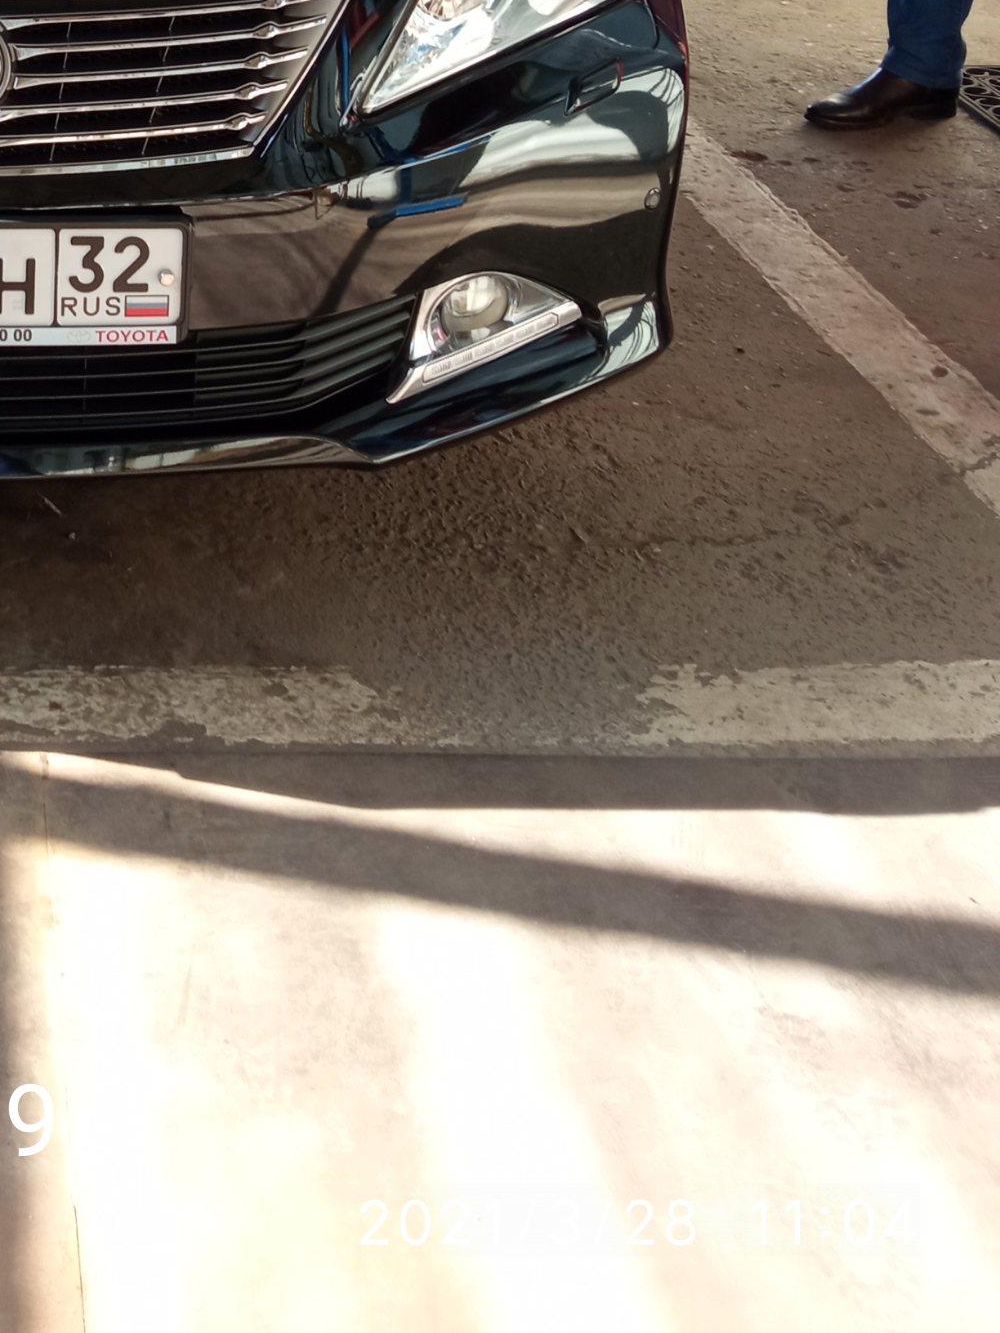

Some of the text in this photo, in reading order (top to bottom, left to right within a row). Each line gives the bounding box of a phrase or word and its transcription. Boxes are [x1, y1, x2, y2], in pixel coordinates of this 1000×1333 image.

[68, 236, 149, 293] 32
[60, 297, 121, 316] RUS
[13, 329, 32, 342] 00
[95, 330, 169, 343] TOYOTA
